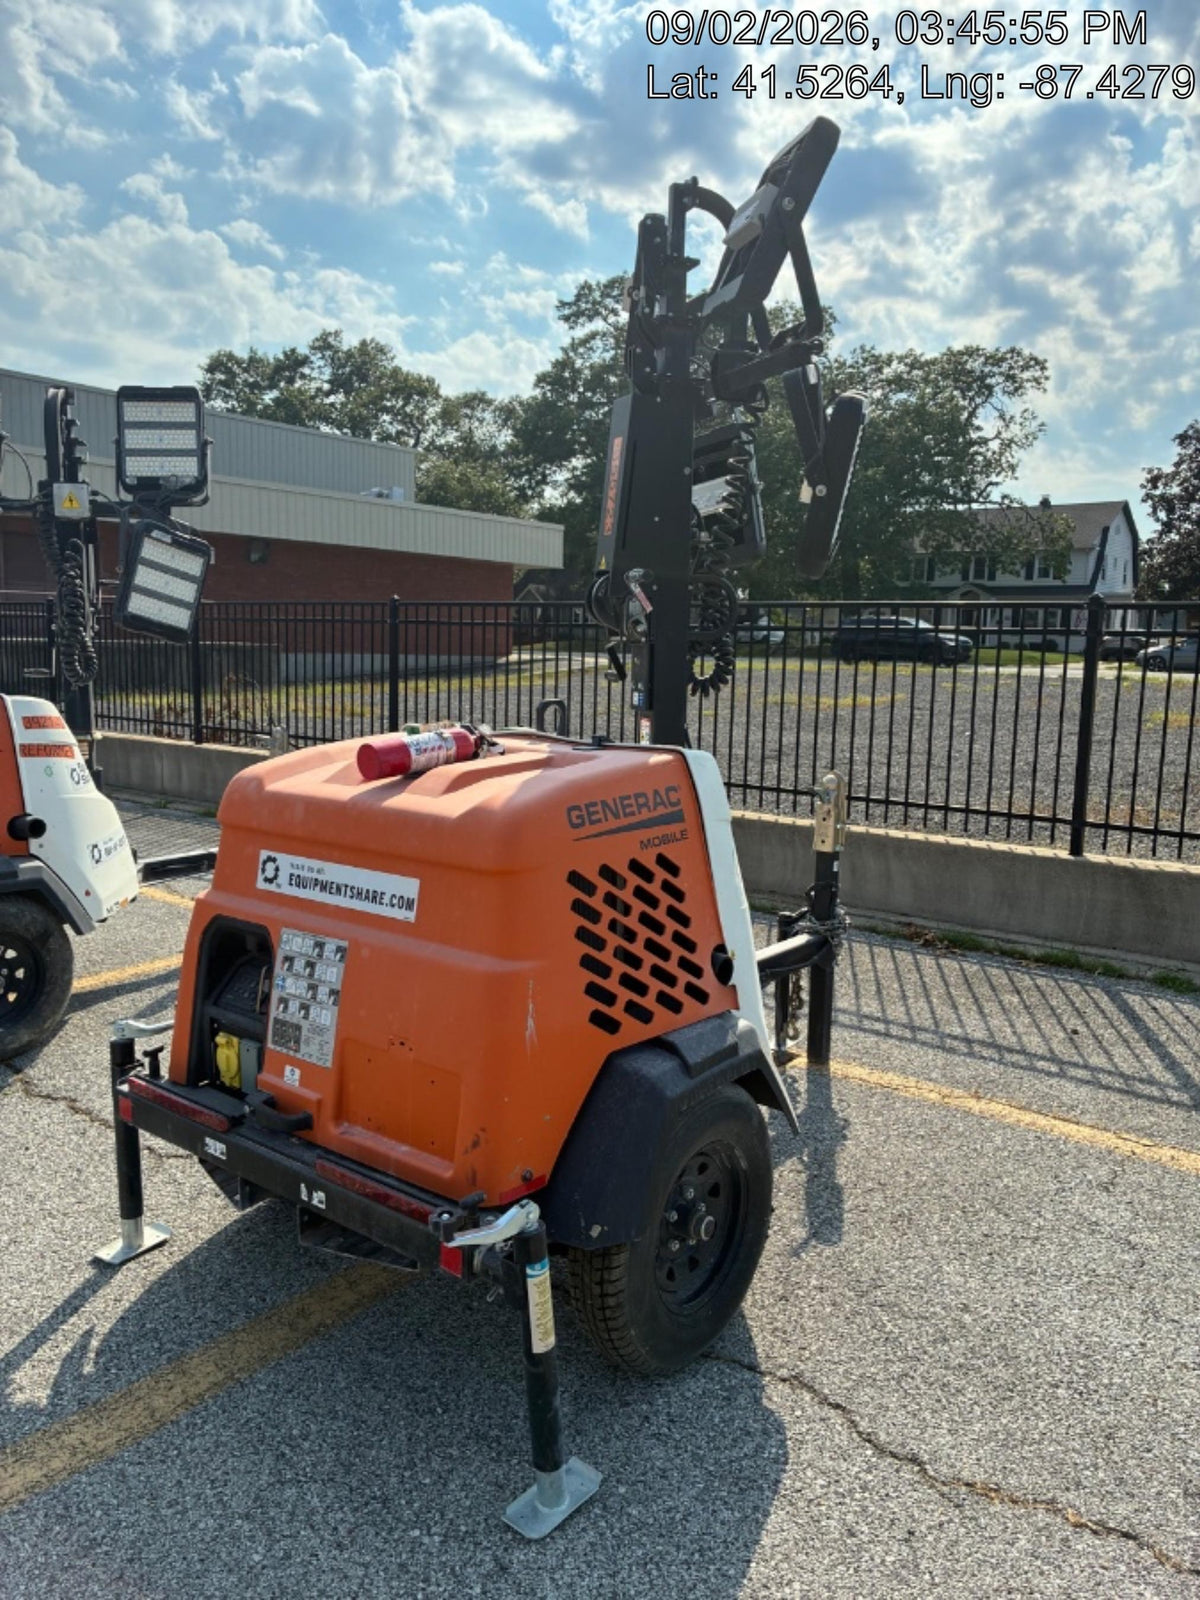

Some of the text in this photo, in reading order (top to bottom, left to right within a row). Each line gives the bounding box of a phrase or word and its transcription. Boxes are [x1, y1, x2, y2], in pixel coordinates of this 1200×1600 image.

[566, 785, 681, 830] GENERAC
[639, 829, 689, 851] MOBILE
[287, 872, 416, 913] EQUIPMENTSHARE.COM
